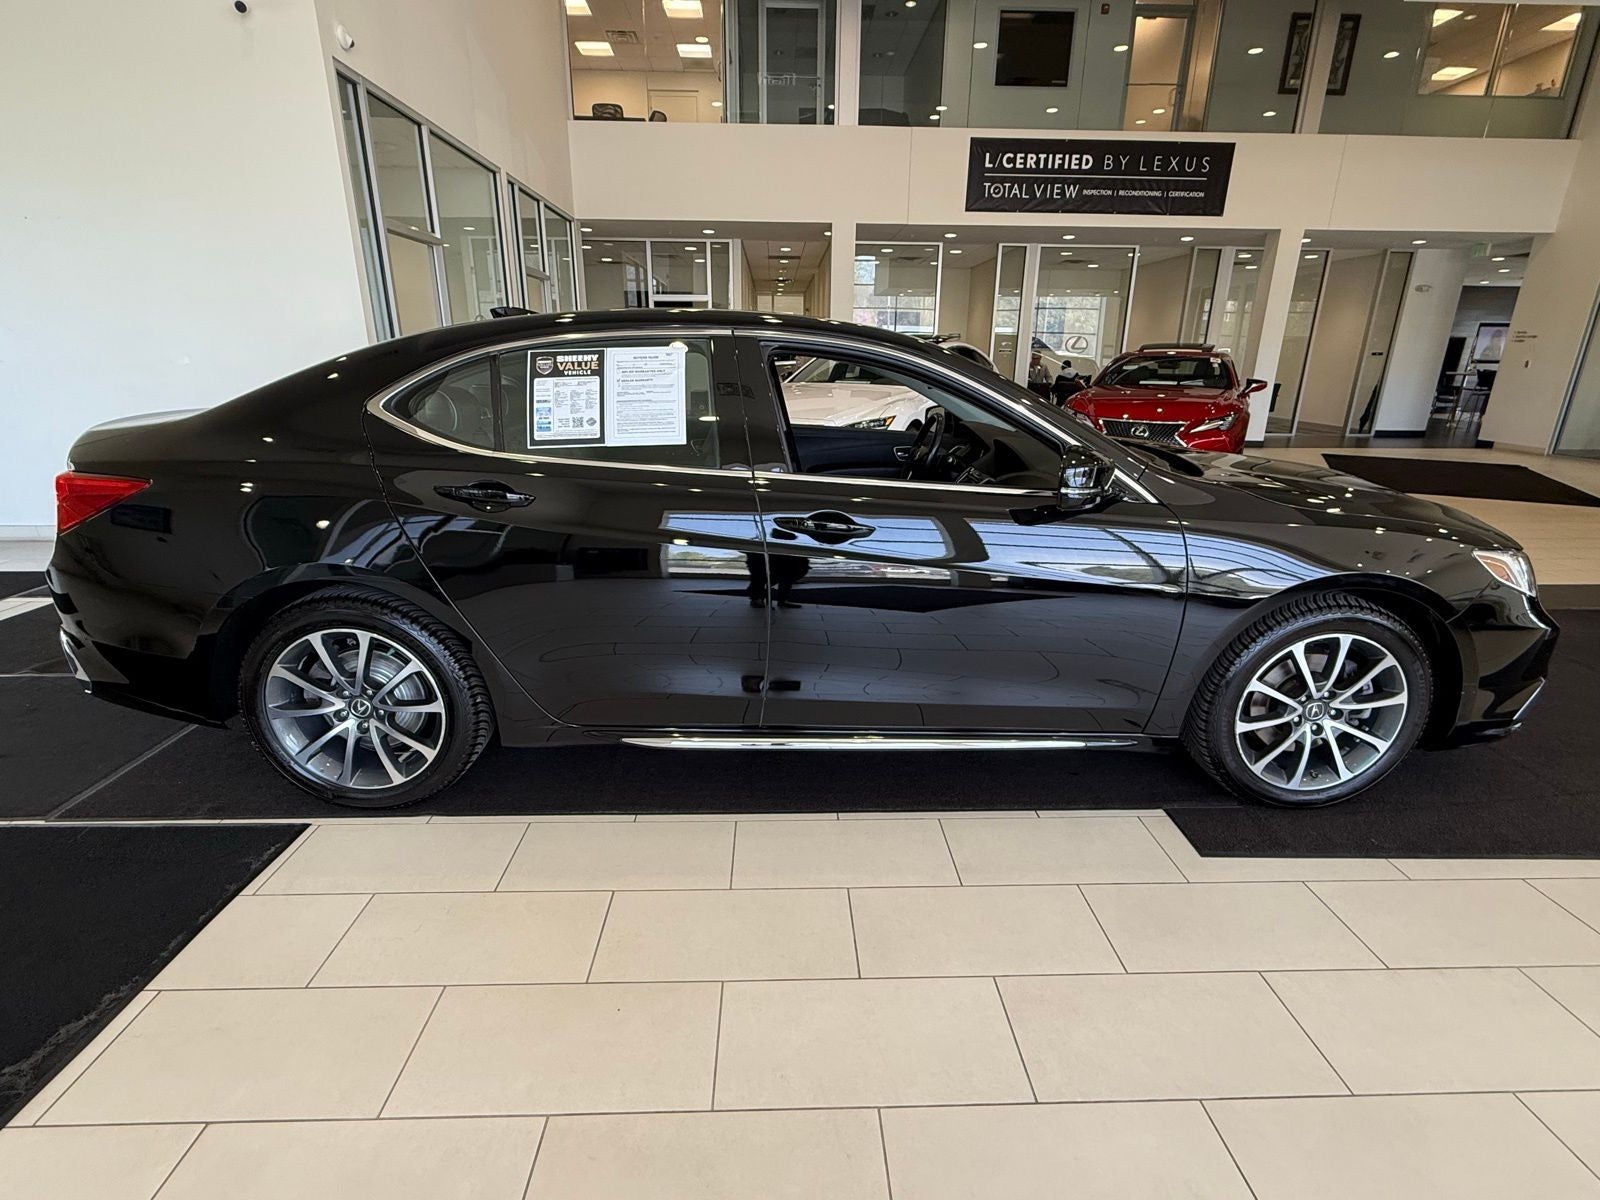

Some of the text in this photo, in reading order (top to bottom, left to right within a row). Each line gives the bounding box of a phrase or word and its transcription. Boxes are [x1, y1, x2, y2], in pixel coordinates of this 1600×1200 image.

[985, 153, 1210, 172] L/CERTIFIED BY LEXUS
[984, 182, 1079, 199] TOTAL VIEW
[557, 361, 599, 370] VALUE
